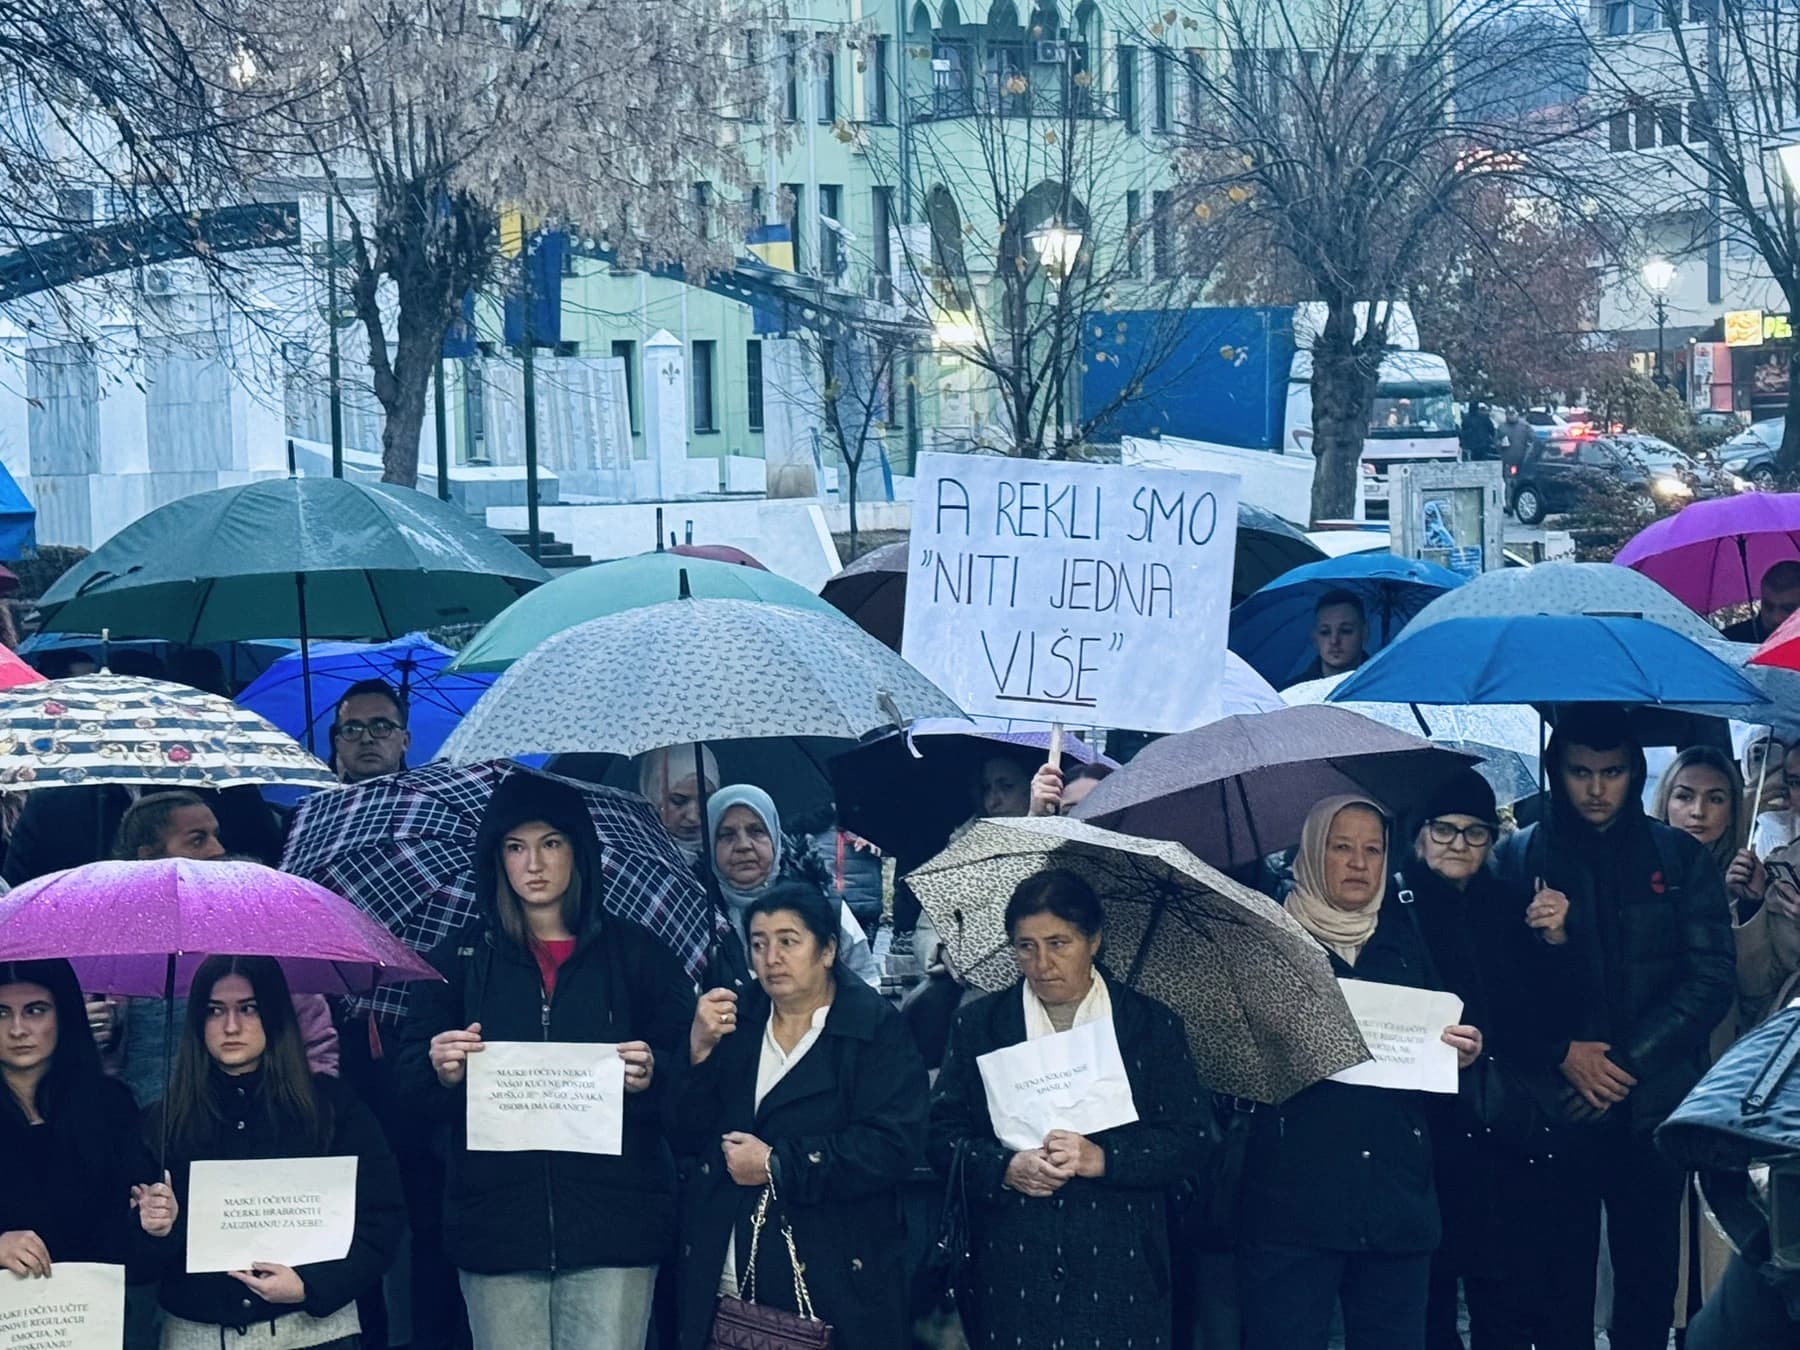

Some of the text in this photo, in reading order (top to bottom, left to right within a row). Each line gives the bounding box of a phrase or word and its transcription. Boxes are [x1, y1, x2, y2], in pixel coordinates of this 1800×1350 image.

[936, 478, 1217, 545] A REKLI SMO
[1050, 558, 1173, 619] JEDNA
[263, 1195, 291, 1204] OČEVI
[293, 1195, 320, 1203] UČITE
[221, 1221, 280, 1229] ZAUZIMANJU
